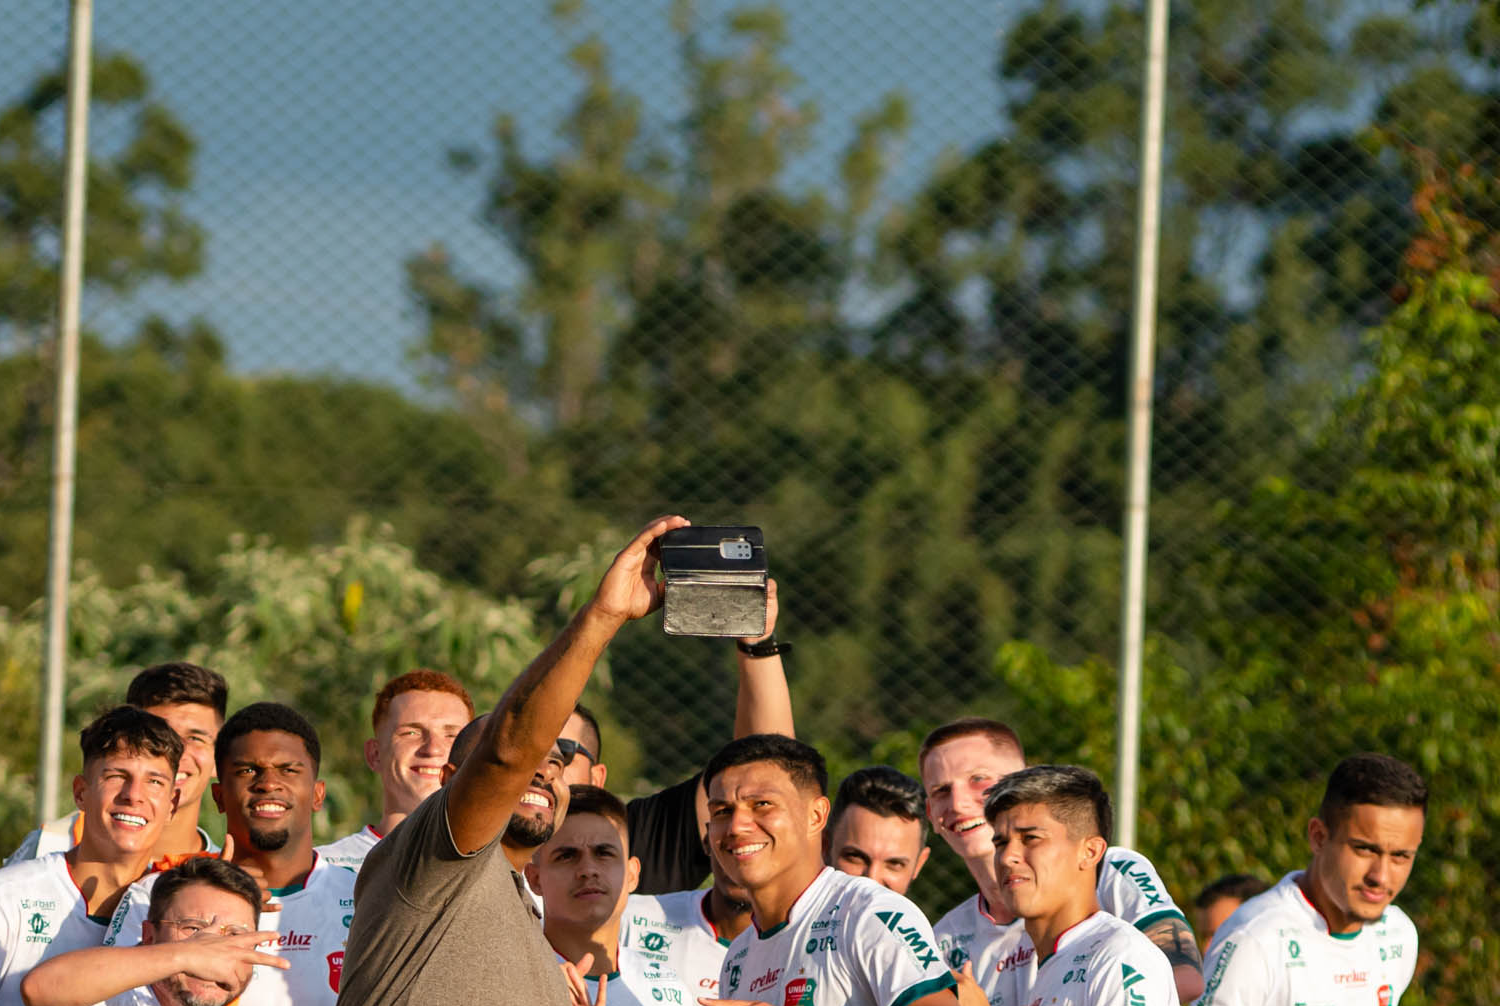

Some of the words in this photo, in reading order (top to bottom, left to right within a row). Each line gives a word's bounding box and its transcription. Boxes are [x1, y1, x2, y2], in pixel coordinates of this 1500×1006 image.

[1129, 871, 1164, 906] JMX
[897, 926, 940, 970] JMX
[699, 978, 719, 990] cr
[788, 983, 813, 994] UNIÃO
